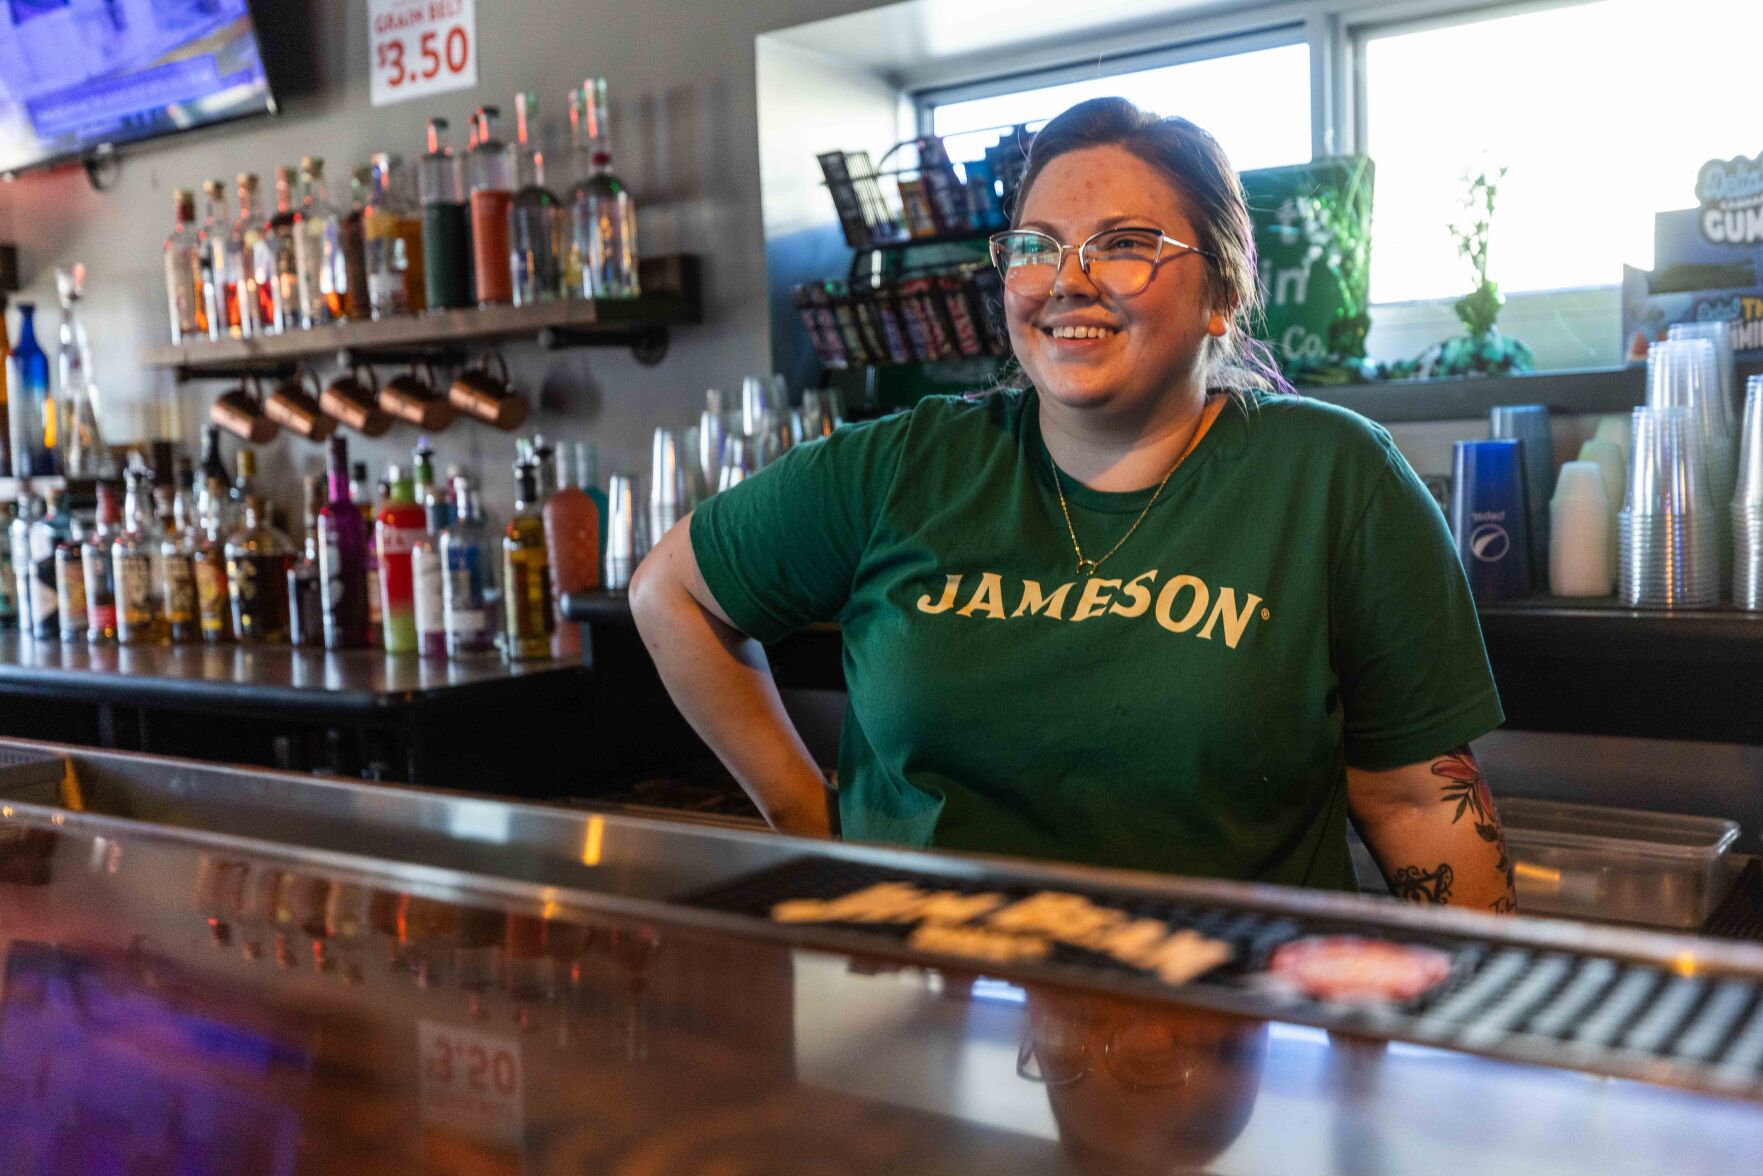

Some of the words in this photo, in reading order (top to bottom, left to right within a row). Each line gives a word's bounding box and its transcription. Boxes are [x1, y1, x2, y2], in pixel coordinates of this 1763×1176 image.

[375, 10, 424, 33] GRAIN
[377, 25, 468, 87] $3.50
[917, 569, 1263, 649] JAMESON
